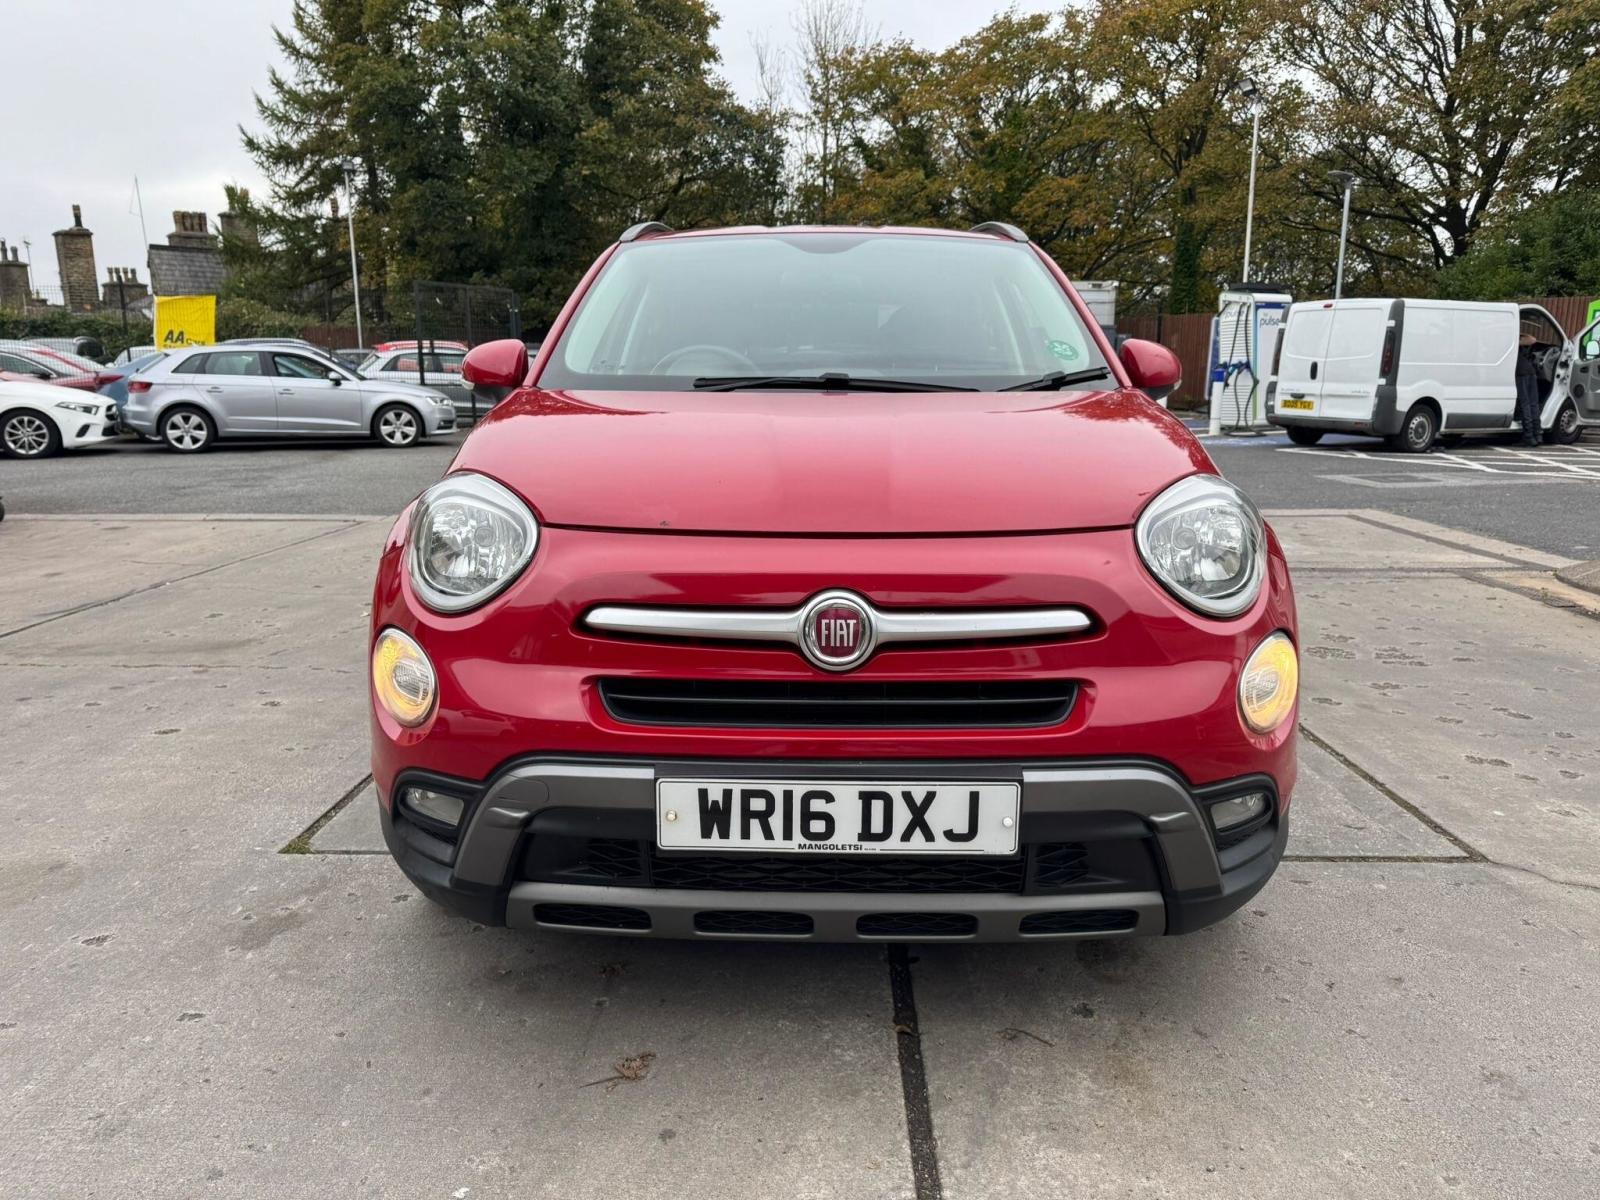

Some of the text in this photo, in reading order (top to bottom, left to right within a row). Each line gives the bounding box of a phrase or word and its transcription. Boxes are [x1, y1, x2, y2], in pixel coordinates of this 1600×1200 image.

[1260, 315, 1280, 328] pulse
[164, 329, 184, 345] AA
[821, 618, 857, 647] FIAT
[697, 787, 980, 843] WR16 DXJ
[798, 843, 863, 851] MANGOLETSI
